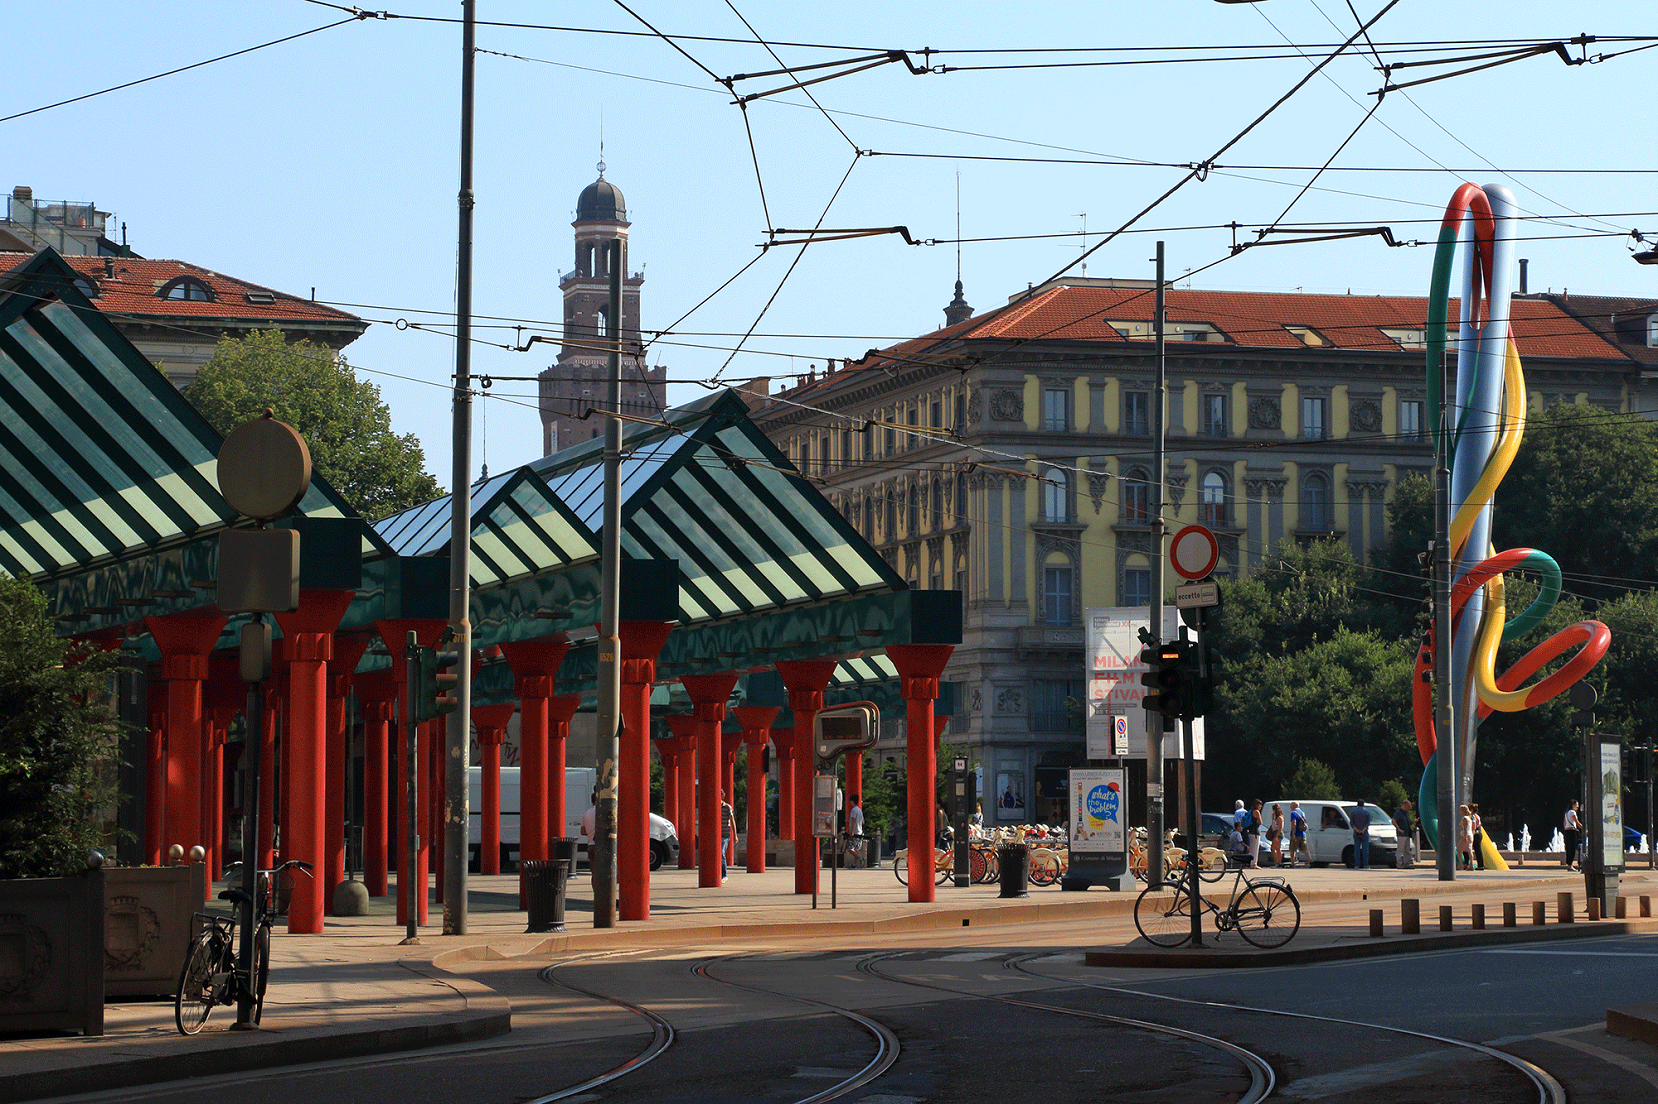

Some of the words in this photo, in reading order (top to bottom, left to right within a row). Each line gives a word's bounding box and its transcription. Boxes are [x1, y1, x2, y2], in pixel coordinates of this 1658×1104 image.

[1178, 592, 1201, 601] eccetto
[1094, 655, 1149, 668] MILAN
[1094, 672, 1134, 684] FILM
[1092, 788, 1116, 801] what's
[1089, 801, 1117, 814] problem
